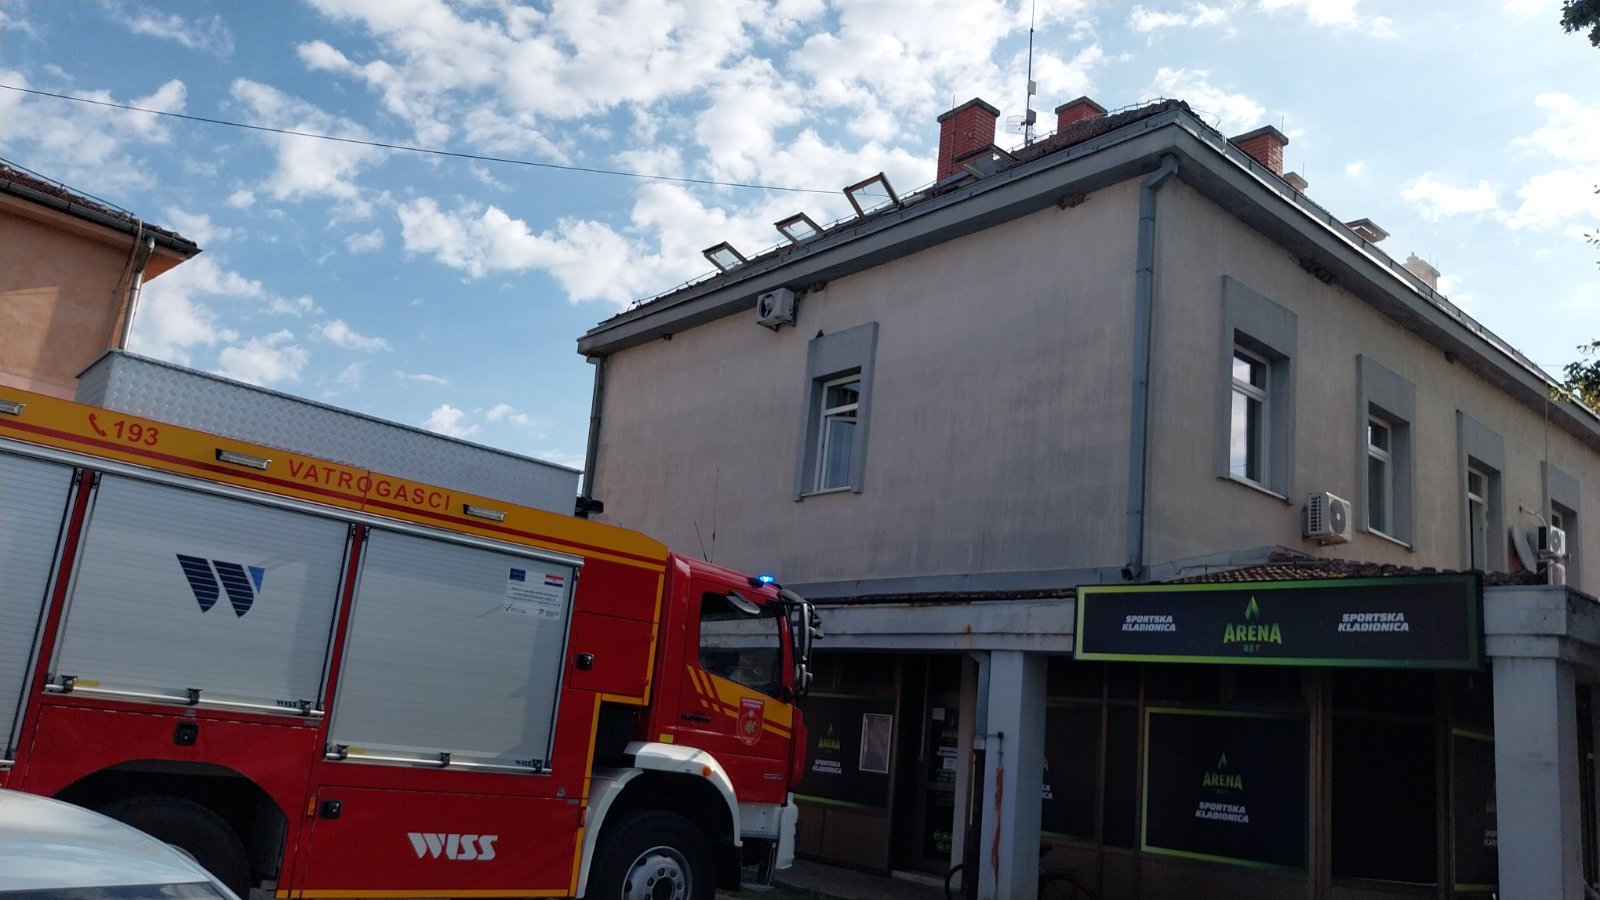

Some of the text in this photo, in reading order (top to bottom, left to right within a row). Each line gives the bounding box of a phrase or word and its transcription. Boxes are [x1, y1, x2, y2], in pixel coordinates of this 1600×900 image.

[114, 421, 158, 446] 193
[288, 459, 451, 510] VATROGASCI
[1125, 615, 1173, 623] SPORTSKA
[1342, 612, 1405, 622] SPORTSKA
[1122, 623, 1176, 631] KLADIONICA
[1223, 623, 1282, 644] ARENA
[1337, 622, 1409, 632] KLADIONICA
[1243, 644, 1261, 653] BET
[1202, 771, 1243, 790] ARENA
[1199, 801, 1246, 814] SPORTSKA
[1195, 809, 1249, 824] KLADIONICA
[407, 832, 499, 861] WISS
